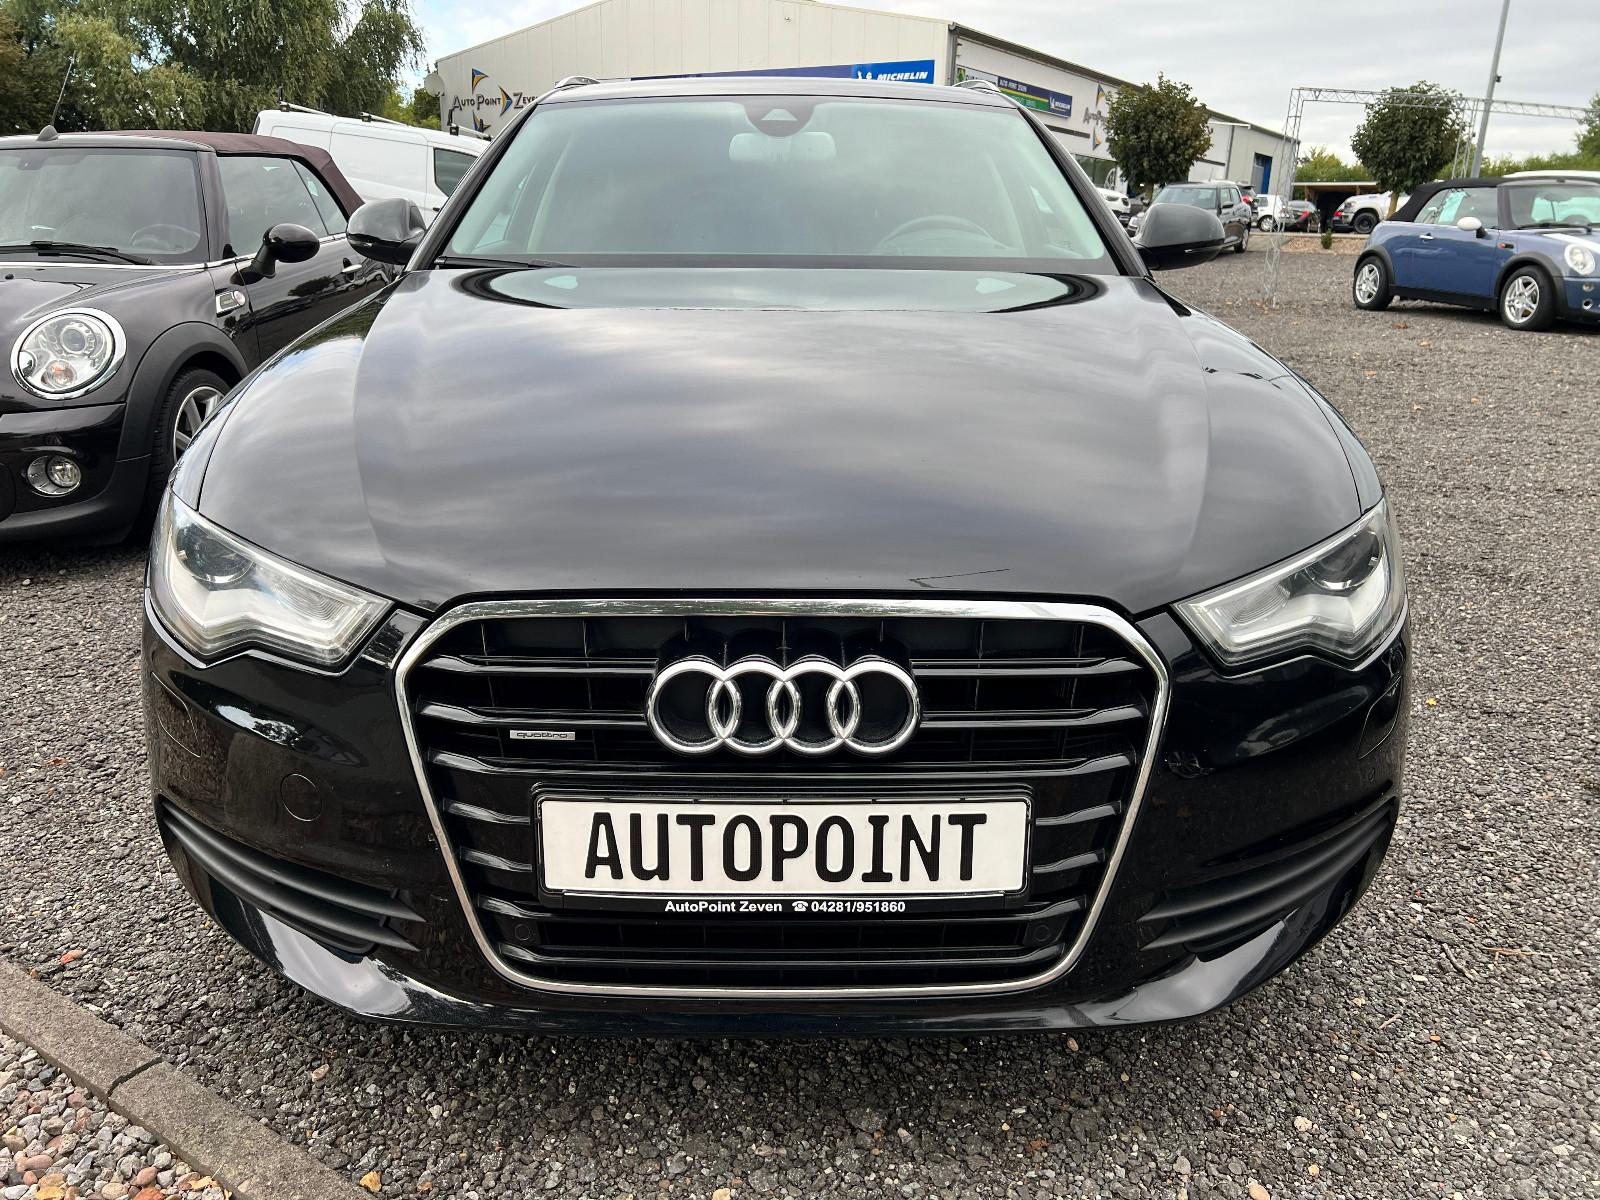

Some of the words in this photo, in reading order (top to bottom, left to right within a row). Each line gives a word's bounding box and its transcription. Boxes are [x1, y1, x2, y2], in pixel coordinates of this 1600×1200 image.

[877, 72, 929, 81] MICHELIN
[453, 95, 475, 111] AUTO
[476, 94, 501, 111] POINT
[513, 92, 538, 109] ZEVE
[585, 811, 988, 883] AUTOPOINT
[664, 901, 736, 913] AutoPoint
[739, 901, 783, 912] Zeven
[811, 901, 906, 913] 04281/951860
